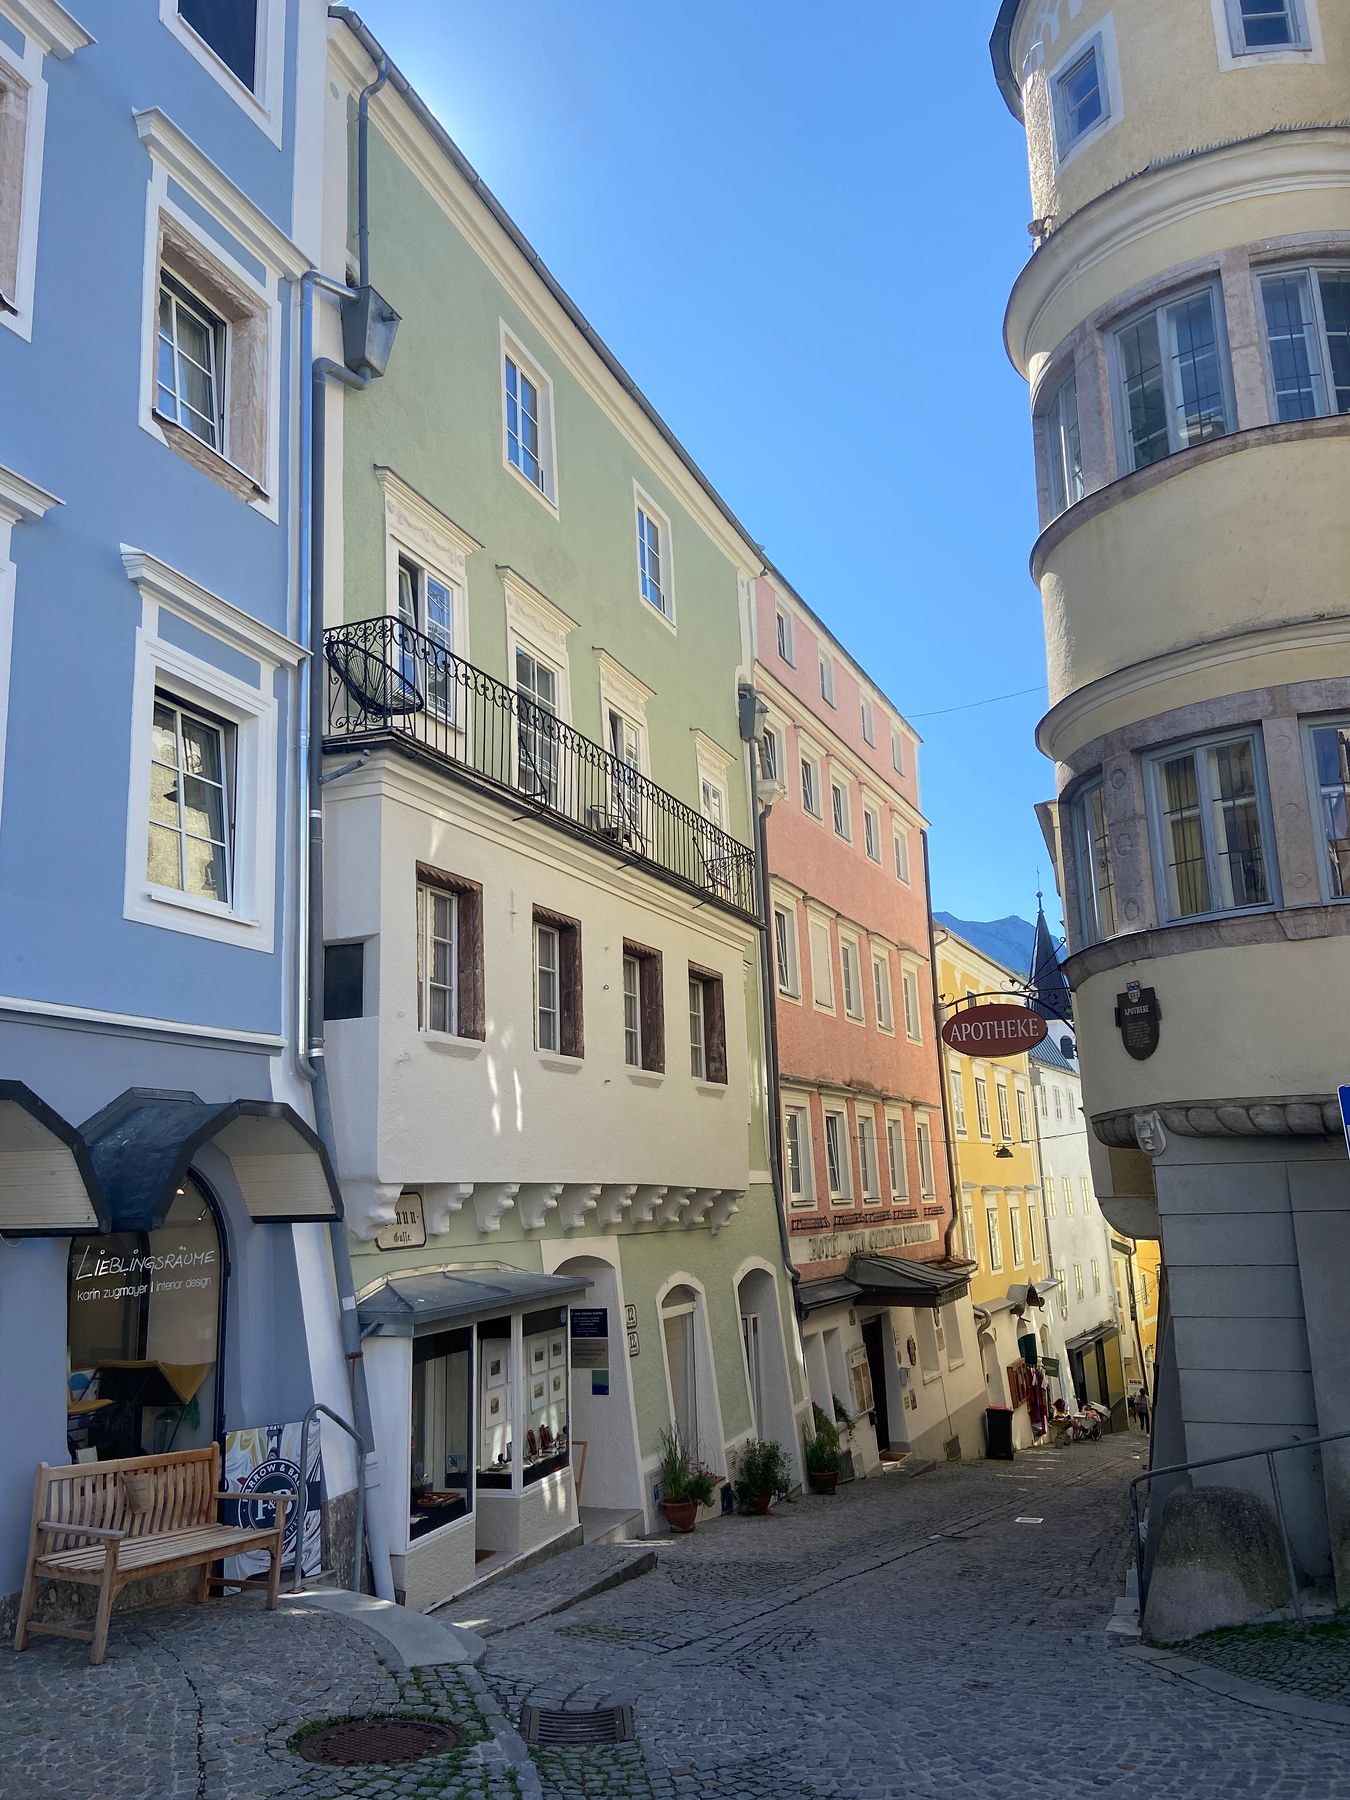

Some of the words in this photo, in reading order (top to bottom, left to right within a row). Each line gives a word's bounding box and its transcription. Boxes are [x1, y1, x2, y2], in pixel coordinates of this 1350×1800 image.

[1124, 1004, 1150, 1016] APOTHEKE
[950, 1018, 1040, 1042] APOTHEKE
[77, 1287, 101, 1301] karin
[103, 1284, 149, 1299] zugmayer
[155, 1279, 183, 1292] interior
[185, 1276, 213, 1290] design
[627, 1307, 634, 1321] 12
[629, 1334, 637, 1348] 12
